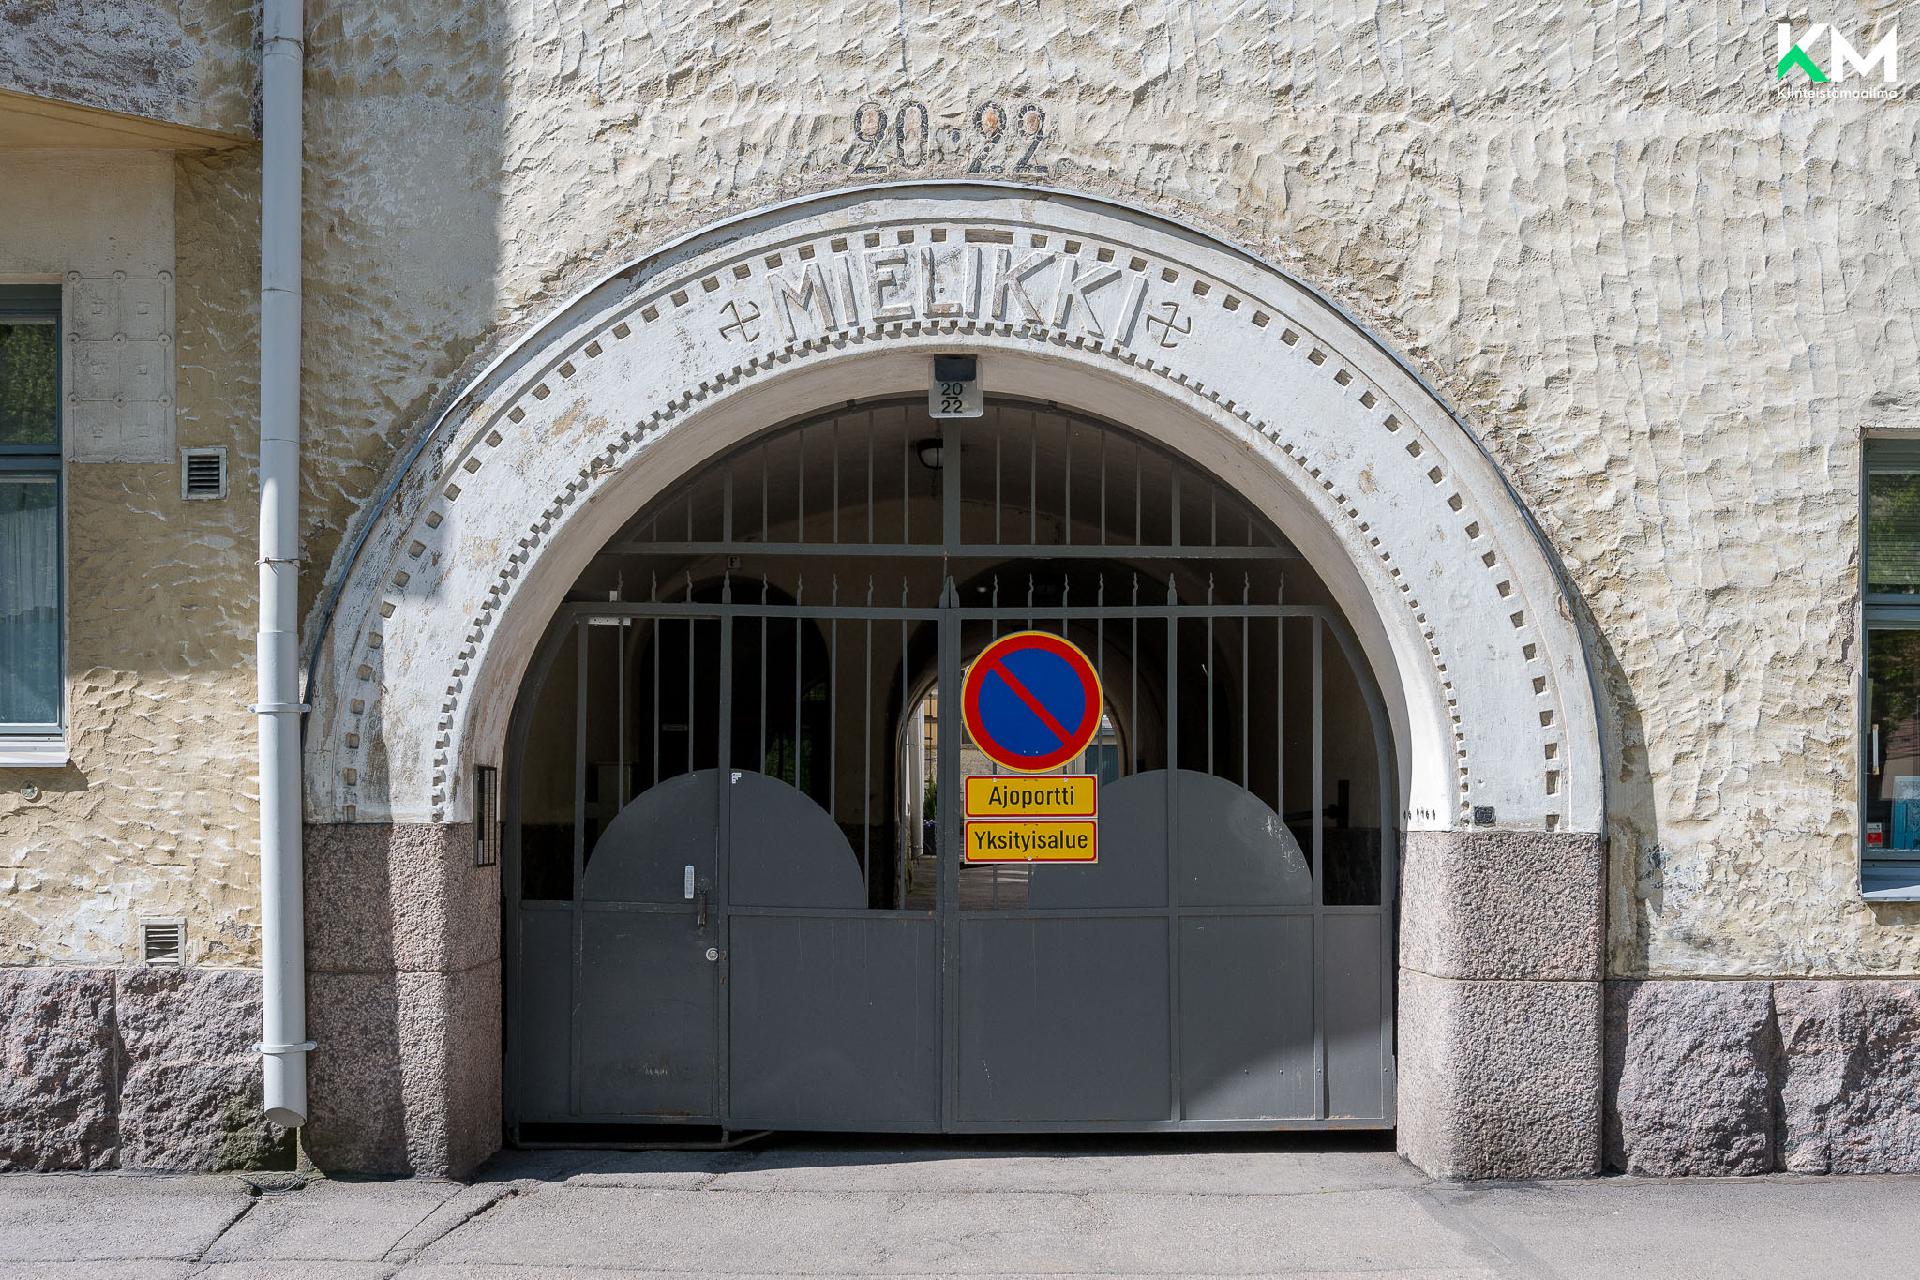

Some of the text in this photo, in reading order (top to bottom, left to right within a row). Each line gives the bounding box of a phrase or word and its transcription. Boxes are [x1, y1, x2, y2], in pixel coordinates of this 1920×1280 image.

[765, 245, 1150, 348] MIELIKKI
[940, 381, 963, 396] 20
[940, 399, 963, 414] 22
[988, 785, 1075, 808] Ajoportti
[974, 829, 1089, 853] Yksityisalue
